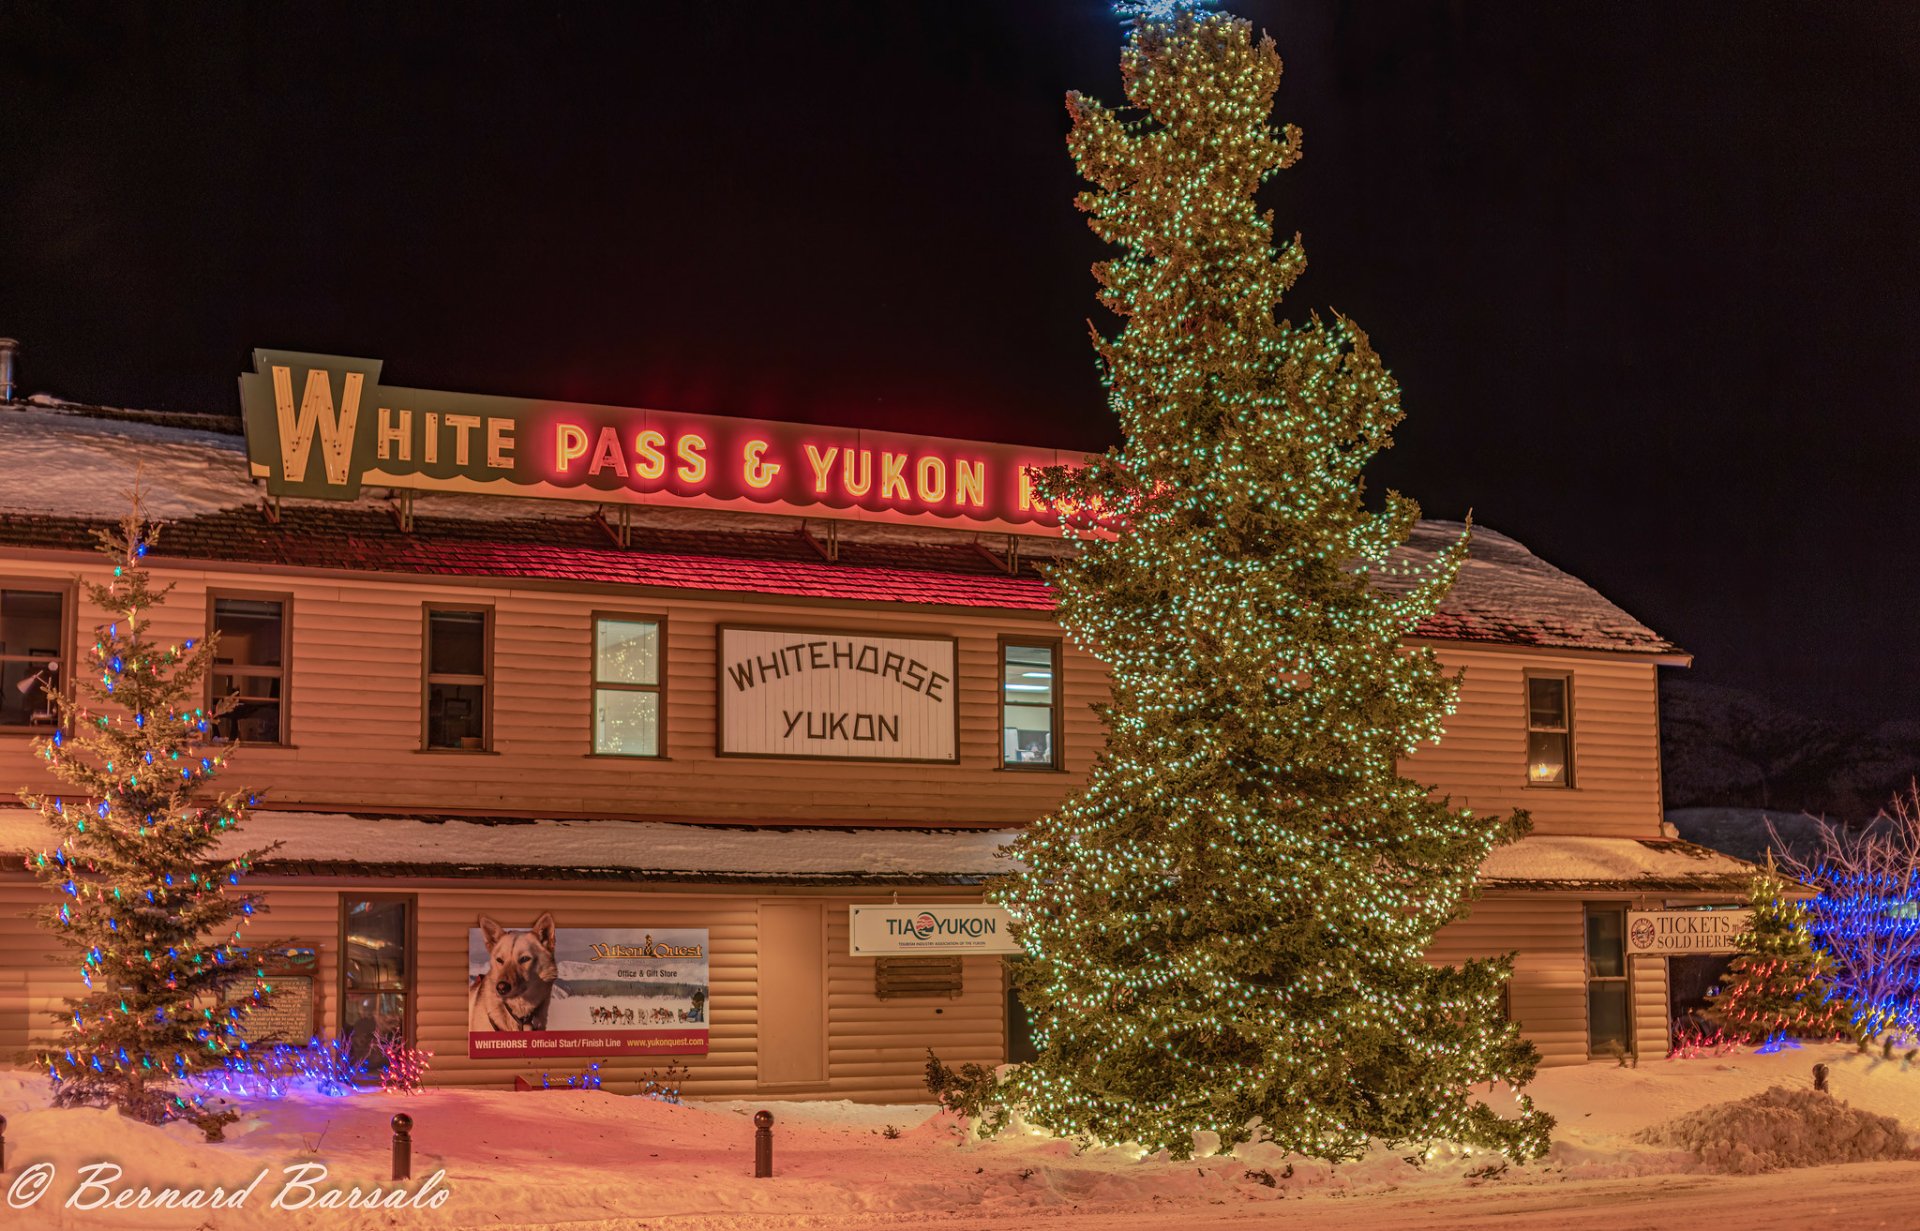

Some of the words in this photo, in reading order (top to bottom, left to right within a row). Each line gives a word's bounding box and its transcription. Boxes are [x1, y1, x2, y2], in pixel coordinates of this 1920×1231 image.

[272, 366, 515, 485] WHITE
[556, 422, 706, 484] PASS
[744, 440, 780, 488] &
[803, 444, 985, 506] YUKON
[728, 641, 950, 703] WHITEHORSE
[782, 711, 899, 742] YUKON
[886, 918, 914, 936] TIA
[936, 918, 996, 937] YUKON
[1657, 916, 1730, 934] TICKETS
[1657, 935, 1691, 949] SOLD
[589, 943, 643, 961] Yukon
[653, 943, 703, 959] Quest
[617, 969, 637, 978] Office
[639, 969, 644, 978] &
[646, 969, 658, 978] Gift
[660, 969, 678, 978] Store
[475, 1040, 528, 1049] WHITEHORSE
[531, 1039, 557, 1048] Official
[605, 1038, 621, 1047] Line
[627, 1038, 704, 1048] www.yukonquest.com
